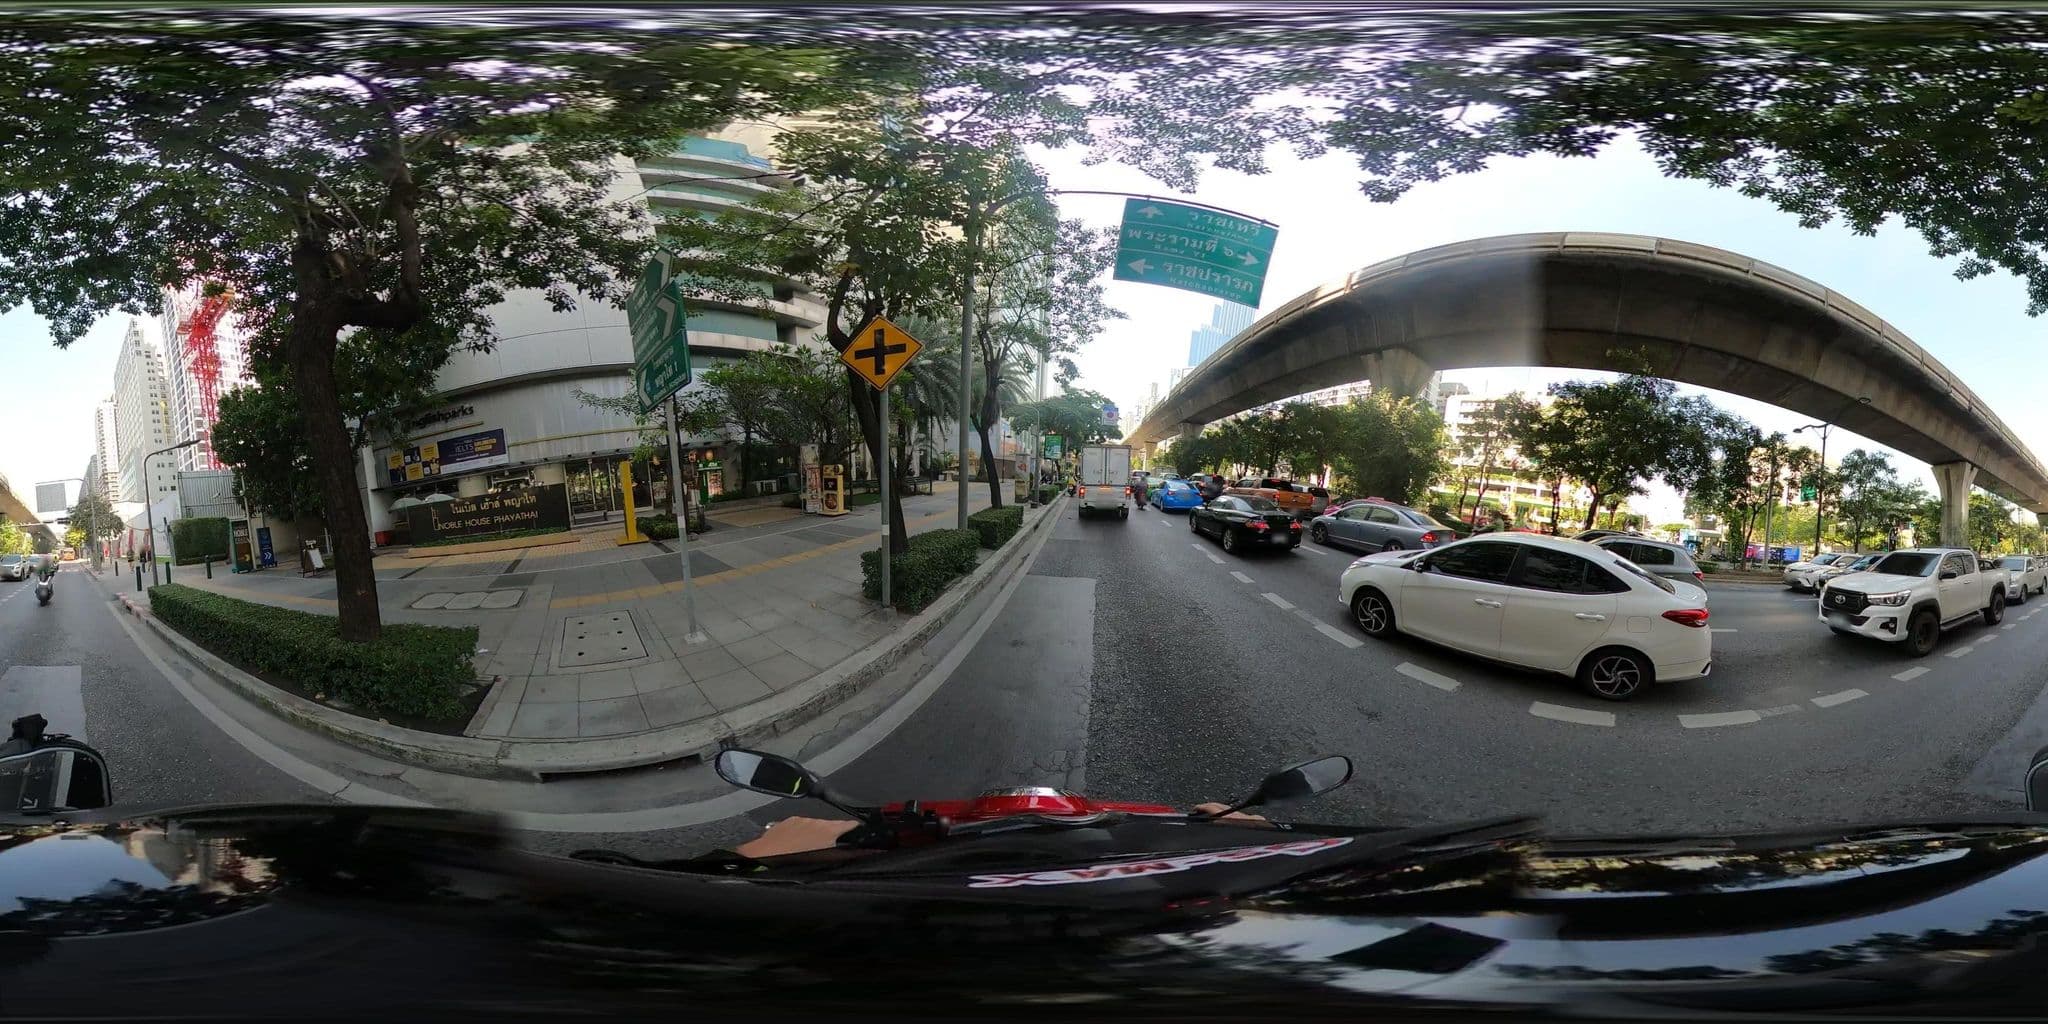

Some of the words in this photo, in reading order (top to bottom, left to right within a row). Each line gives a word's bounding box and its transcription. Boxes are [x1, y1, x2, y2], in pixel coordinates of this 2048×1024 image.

[1189, 210, 1261, 235] ราชเทวี
[1129, 229, 1218, 252] พระรามที่
[1163, 262, 1253, 292] ราชปรารภ
[455, 443, 474, 453] IELTS
[450, 502, 476, 514] โนเบิล
[504, 493, 536, 507] พญาไท
[438, 520, 462, 531] NOBLE
[465, 517, 491, 527] HOUSE
[494, 511, 538, 523] PHAYATHAI
